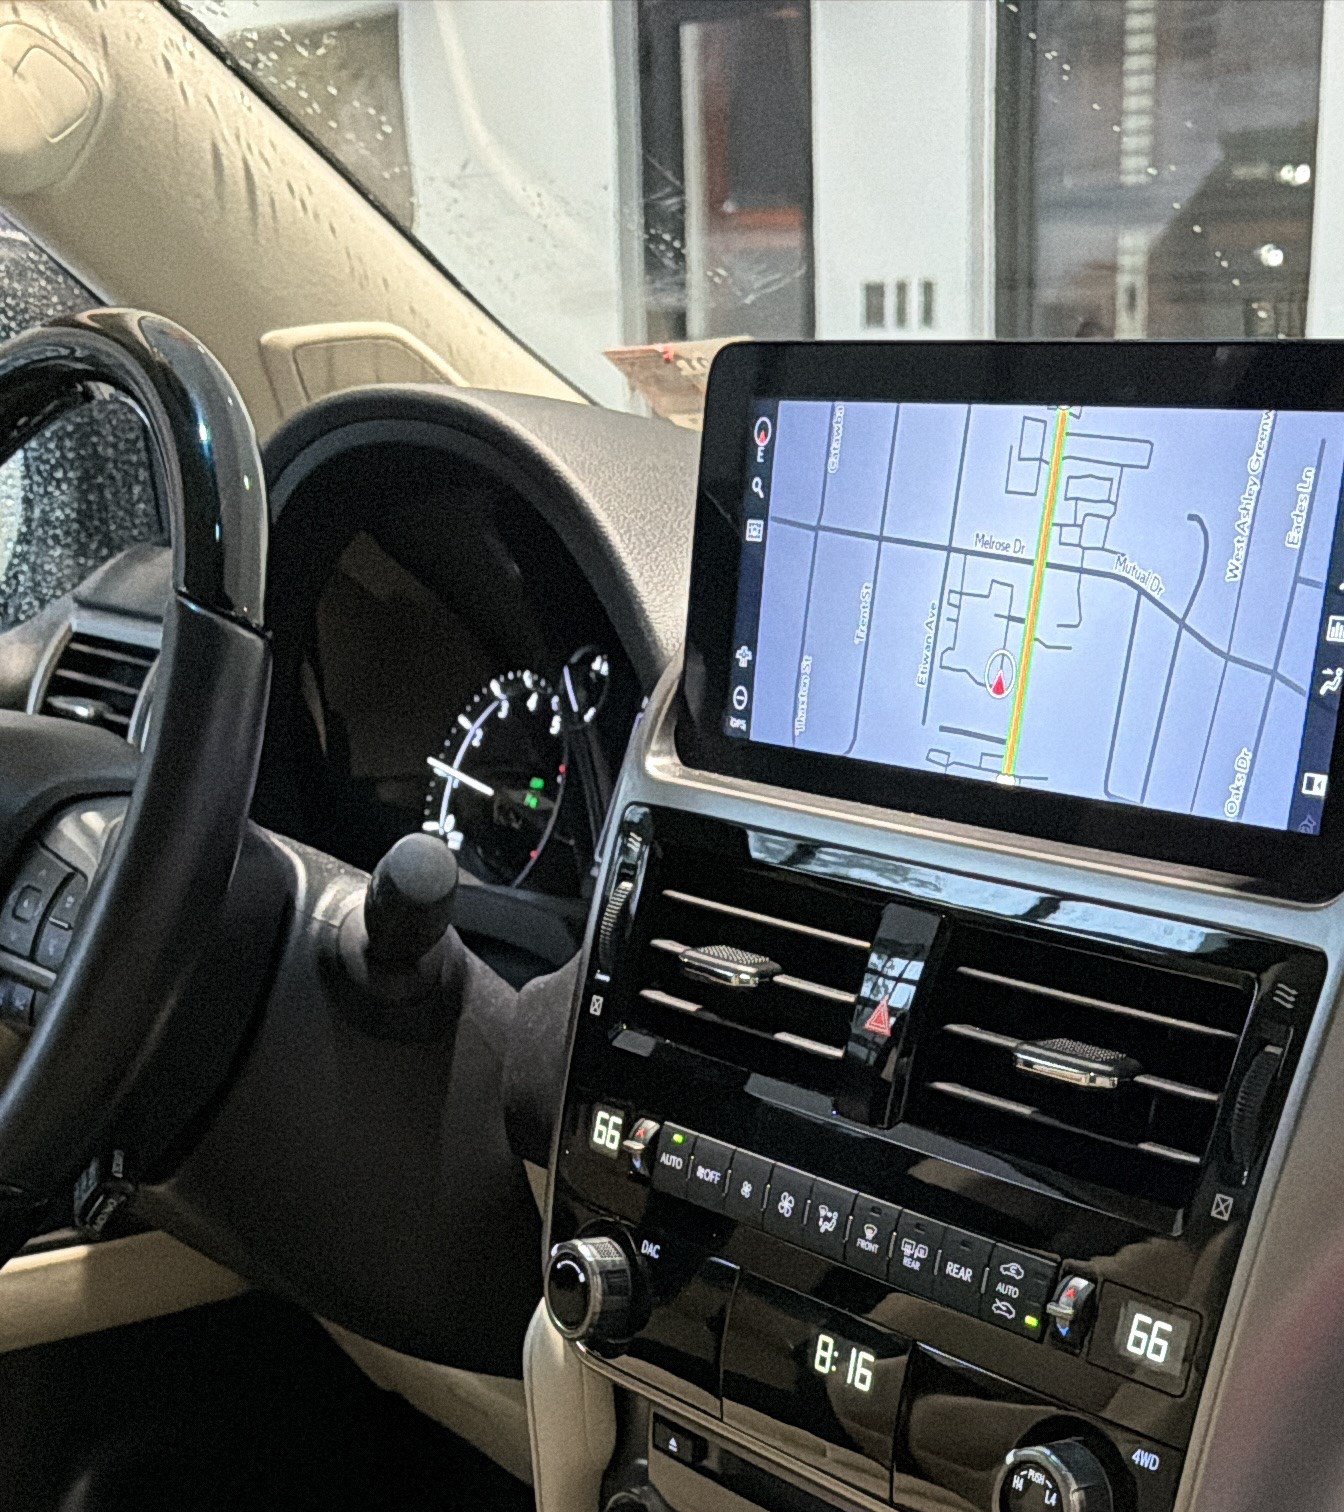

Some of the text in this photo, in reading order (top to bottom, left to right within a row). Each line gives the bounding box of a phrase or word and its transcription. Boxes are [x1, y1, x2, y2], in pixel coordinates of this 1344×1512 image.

[1286, 468, 1314, 548] Eades Ln
[1226, 538, 1244, 581] West
[1236, 477, 1260, 535] Ashley
[975, 533, 1025, 554] Melrose Dr
[1115, 556, 1164, 595] Mutual Dr
[918, 602, 937, 686] Etiwan Ave
[1225, 749, 1251, 816] Oaks Dr
[593, 1110, 623, 1150] 66
[660, 1152, 683, 1170] AUTO
[705, 1168, 721, 1184] OFF
[641, 1240, 660, 1259] DAC
[856, 1238, 879, 1254] FRONT
[902, 1256, 921, 1271] REAR
[945, 1261, 973, 1282] REAR
[995, 1282, 1019, 1298] AUTO
[1127, 1313, 1172, 1363] 66
[814, 1334, 875, 1392] 8:16
[1131, 1449, 1160, 1471] 4WD
[1012, 1475, 1024, 1492] H4
[1027, 1469, 1046, 1485] PUSH
[1044, 1489, 1058, 1506] L4
